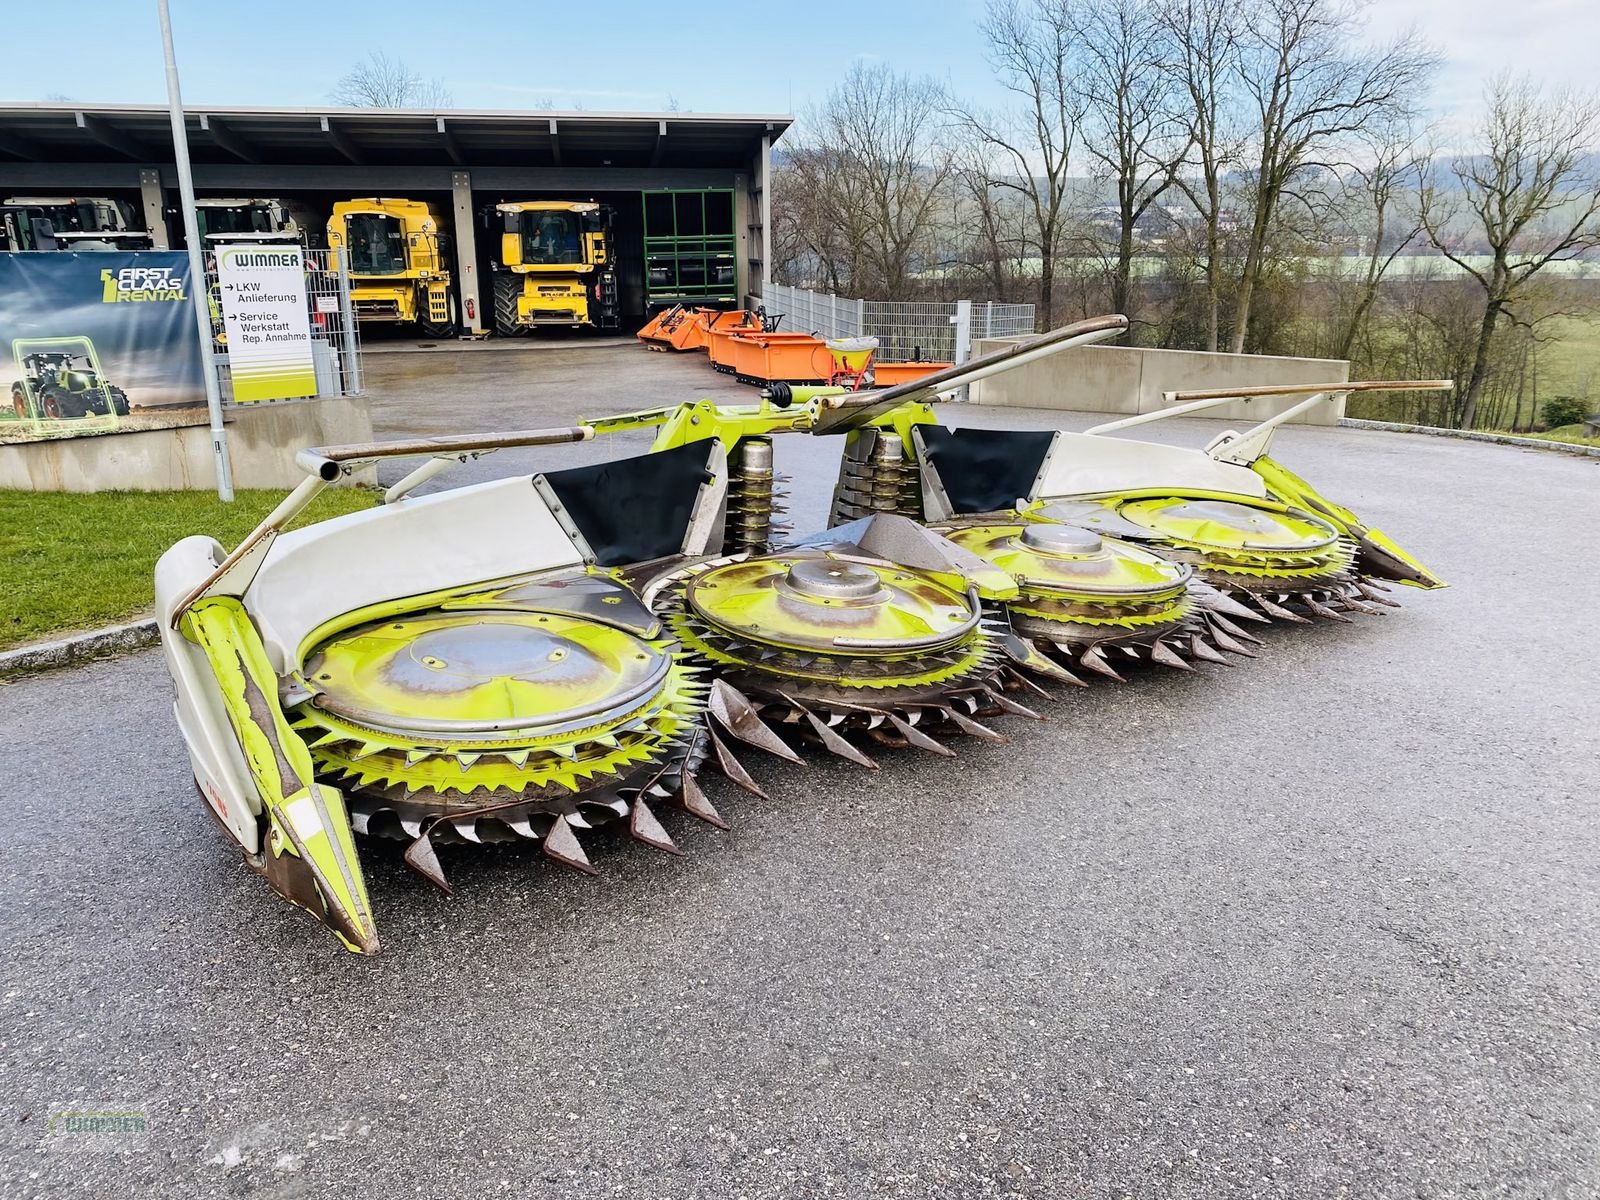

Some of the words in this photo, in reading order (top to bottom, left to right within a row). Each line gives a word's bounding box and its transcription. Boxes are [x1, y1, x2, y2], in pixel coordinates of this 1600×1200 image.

[234, 254, 299, 267] WIMMER
[118, 267, 173, 280] FIRST
[118, 278, 182, 291] CLAAS
[236, 282, 261, 292] LKW
[117, 289, 188, 303] RENTAL
[238, 293, 297, 303] Anlieferung
[239, 312, 278, 321] Service
[241, 322, 290, 332] Werkstatt
[242, 334, 263, 344] Rep.
[265, 333, 307, 342] Annahme
